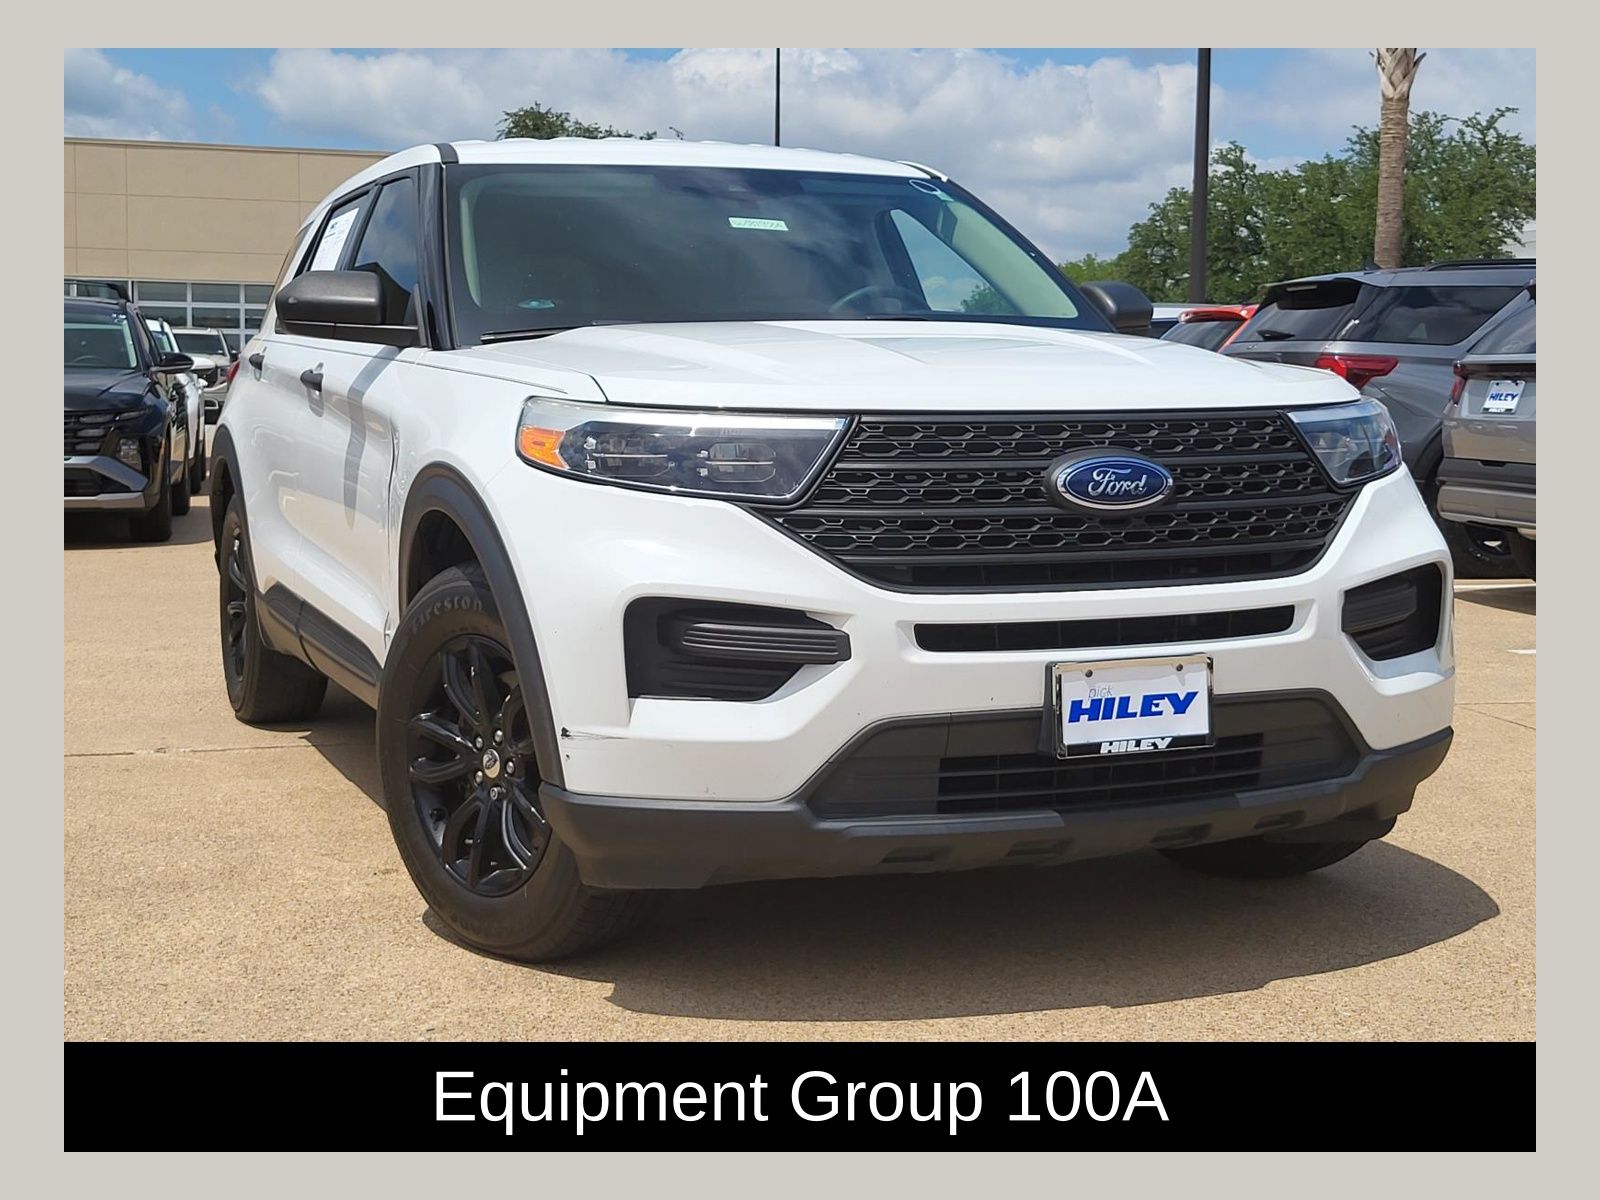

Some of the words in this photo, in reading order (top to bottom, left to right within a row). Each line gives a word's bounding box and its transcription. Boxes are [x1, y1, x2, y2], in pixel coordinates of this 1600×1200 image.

[1488, 392, 1519, 401] HILEY
[1088, 467, 1147, 496] Ford
[1068, 691, 1199, 723] HILEY
[1101, 737, 1172, 754] HILEY
